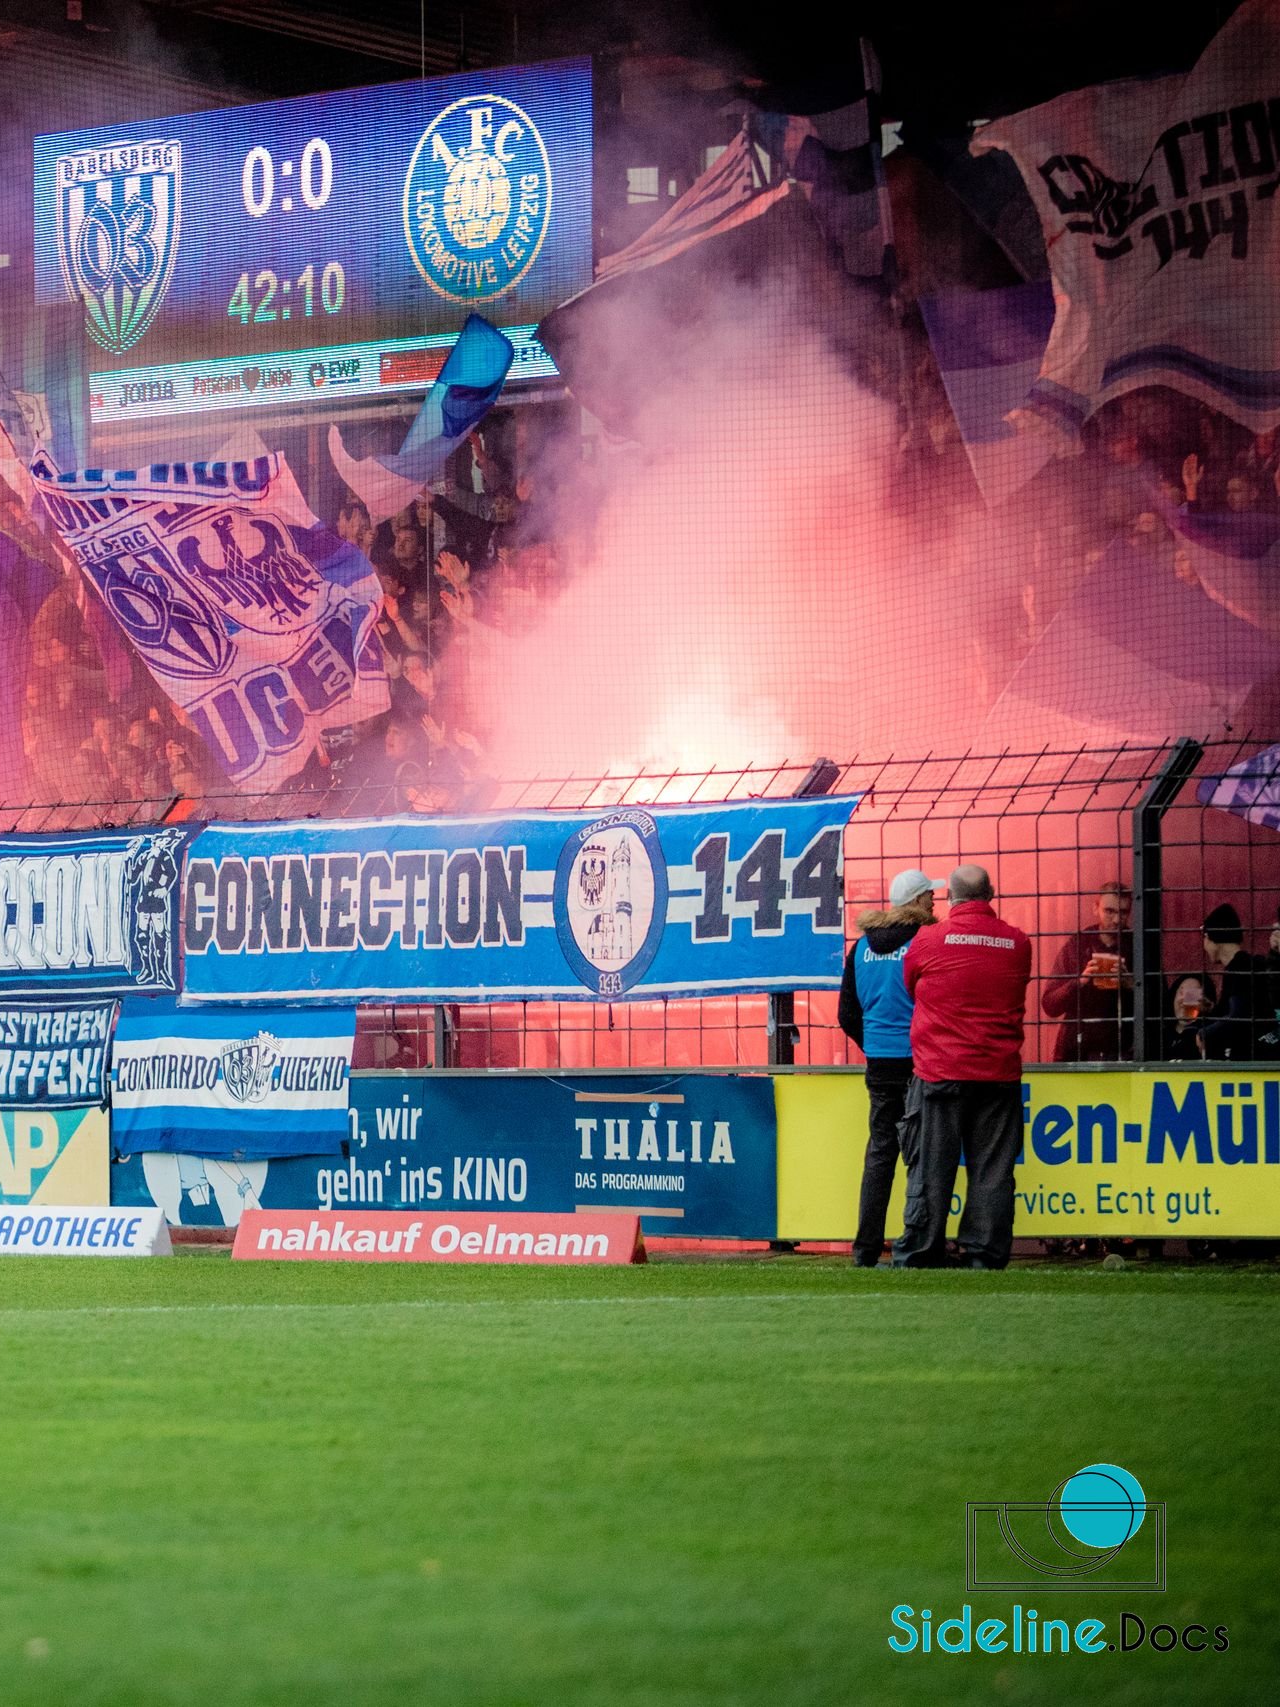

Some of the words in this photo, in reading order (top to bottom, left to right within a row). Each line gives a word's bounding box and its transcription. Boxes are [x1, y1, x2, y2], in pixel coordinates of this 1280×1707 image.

[64, 147, 174, 180] BABELSBERG
[241, 137, 334, 217] 0:0
[75, 193, 158, 292] 03
[417, 189, 498, 288] LOKOMOTIVE
[500, 173, 540, 270] LEIPZIG
[227, 262, 346, 324] 42:10
[328, 359, 361, 377] EWP
[579, 809, 656, 842] CONNECTION
[184, 846, 524, 955] CONNECTION
[691, 825, 845, 944] 144
[943, 934, 1017, 950] ABSCHNITTSLEITER
[599, 973, 622, 993] 144
[271, 1055, 347, 1092] JUGEND
[376, 1094, 423, 1141] wir
[401, 1156, 443, 1203] ins
[452, 1157, 528, 1202] KINO
[575, 1172, 597, 1190] DAS
[601, 1174, 686, 1193] PROGRAMMKINO
[1165, 1186, 1221, 1224] gut.
[257, 1221, 423, 1253] nahkauf
[430, 1223, 610, 1258] Oelmann
